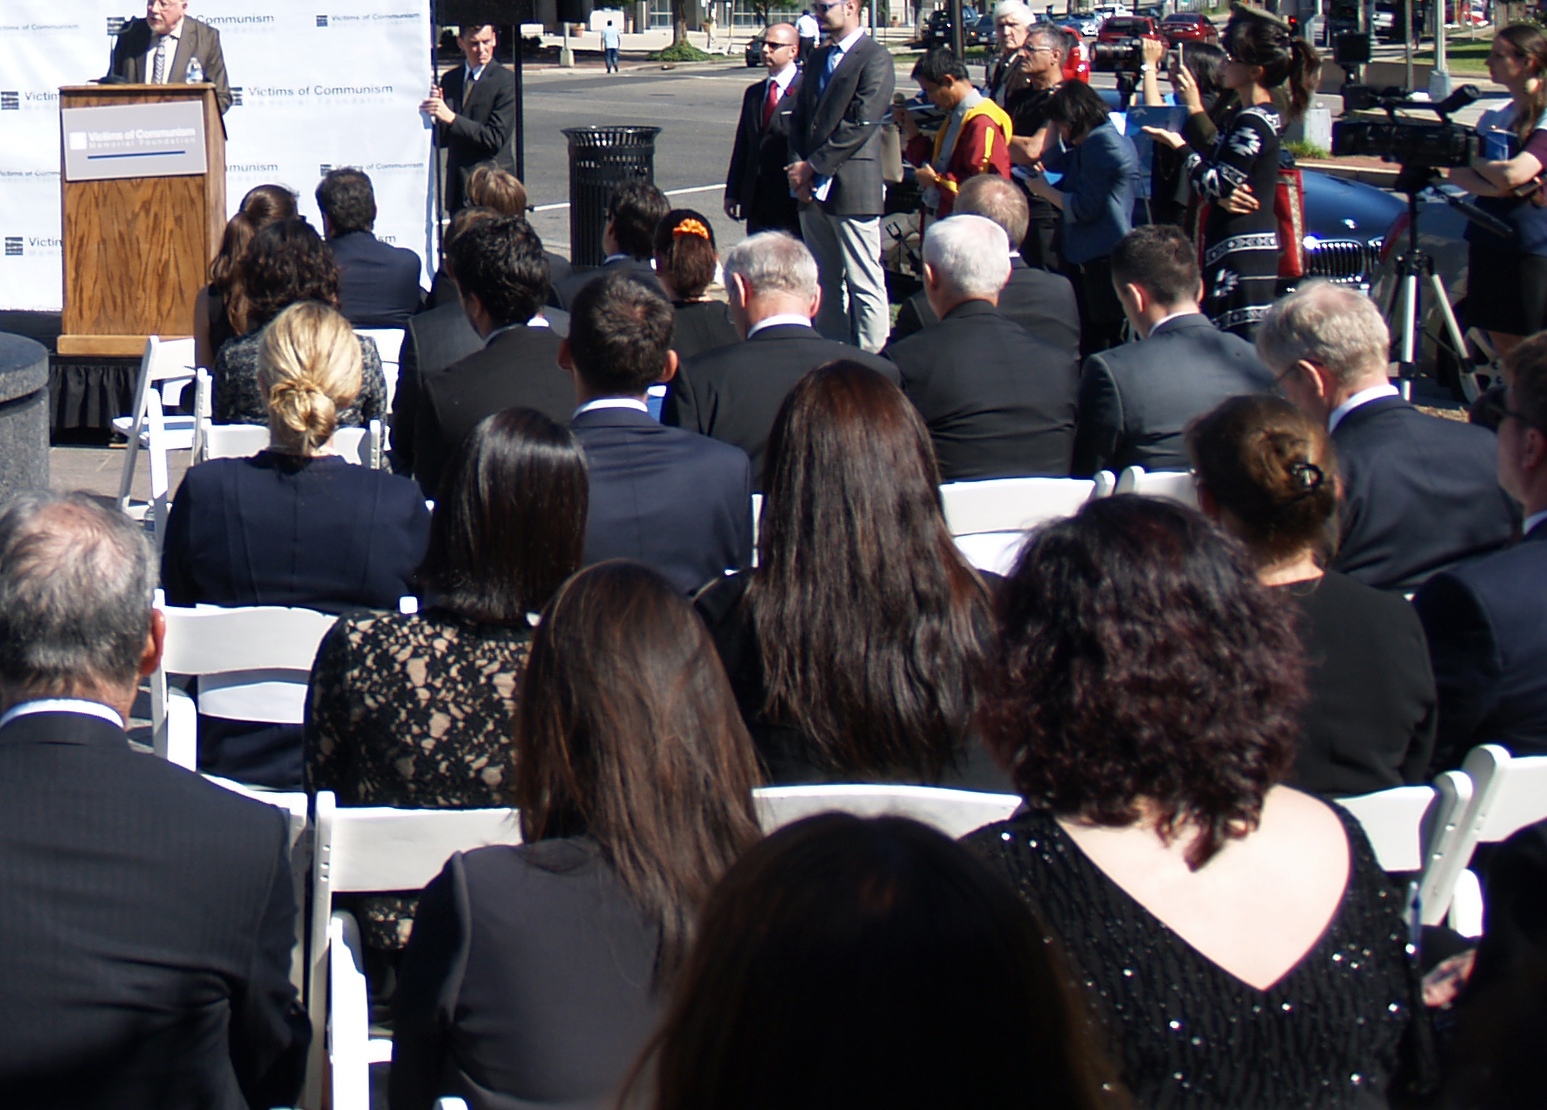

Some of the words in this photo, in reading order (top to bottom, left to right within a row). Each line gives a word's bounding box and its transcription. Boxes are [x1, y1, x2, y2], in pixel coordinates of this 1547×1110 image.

[248, 87, 294, 97] Victims
[298, 86, 310, 96] of
[314, 84, 393, 96] Communism
